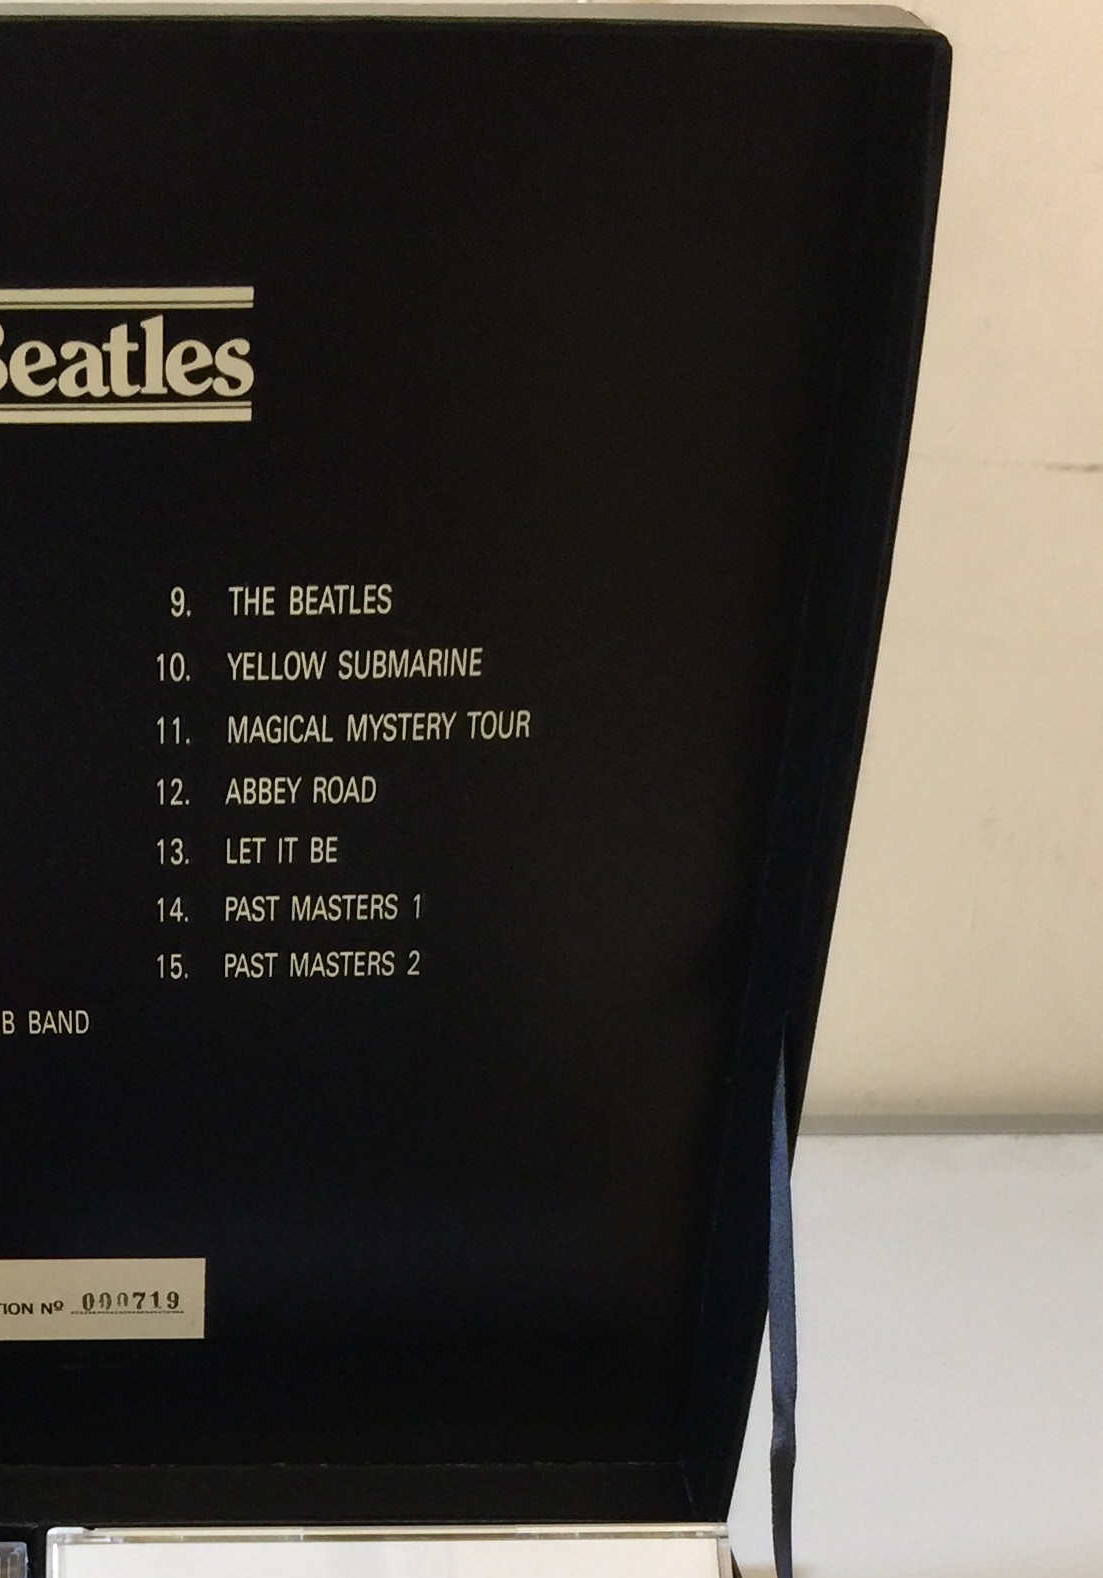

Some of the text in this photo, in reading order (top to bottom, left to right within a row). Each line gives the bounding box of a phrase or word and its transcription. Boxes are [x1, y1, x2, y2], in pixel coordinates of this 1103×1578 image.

[170, 583, 393, 618] 9. THE BEATLES
[156, 647, 484, 682] 10. YELLOW SUBMARINE
[156, 709, 531, 745] 11. MAGICAL MYSTERY TOUR
[156, 775, 377, 806] 12. ABBEY ROAD
[156, 836, 339, 866] 13. LET IT BE
[157, 893, 421, 923] 14. PAST MASTERS 1
[156, 949, 421, 980] 15. PAST MASTERS 2
[28, 1009, 90, 1035] BAND
[81, 1290, 180, 1311] 000719
